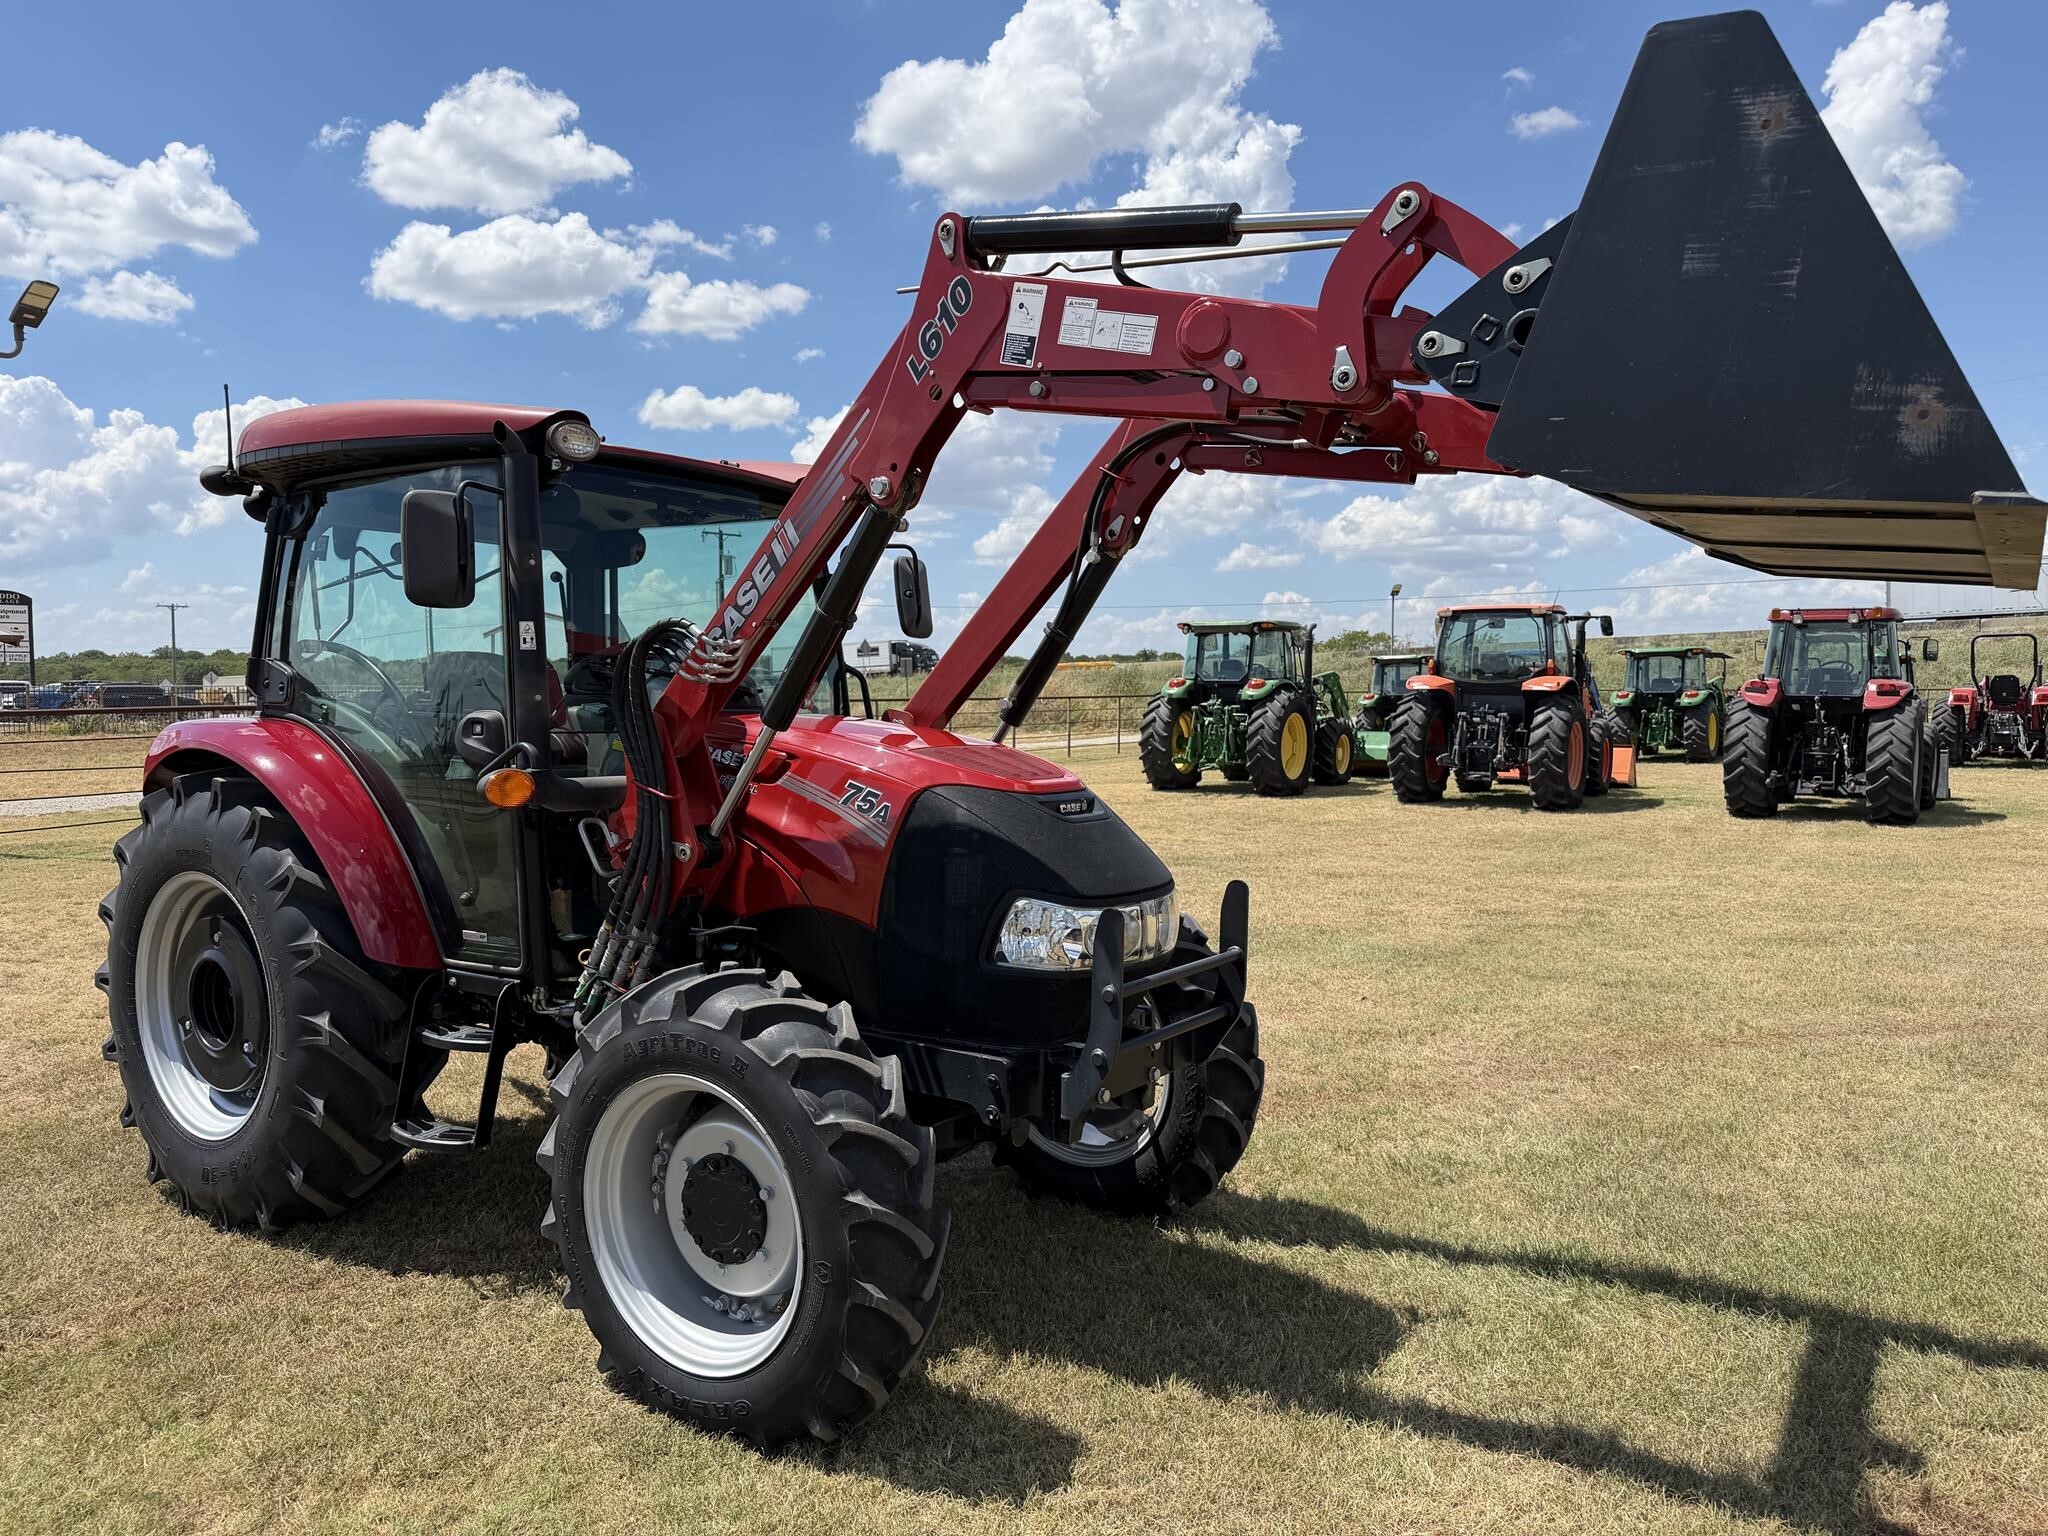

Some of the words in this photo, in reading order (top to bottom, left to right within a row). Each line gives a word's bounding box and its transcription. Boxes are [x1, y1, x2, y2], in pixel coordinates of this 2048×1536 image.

[1022, 288, 1044, 296] WARNING
[906, 274, 973, 386] L610
[839, 780, 891, 825] 75A
[1060, 803, 1081, 813] CASE
[623, 1031, 721, 1062] AgriTrac
[627, 1365, 752, 1420] GALAXY
